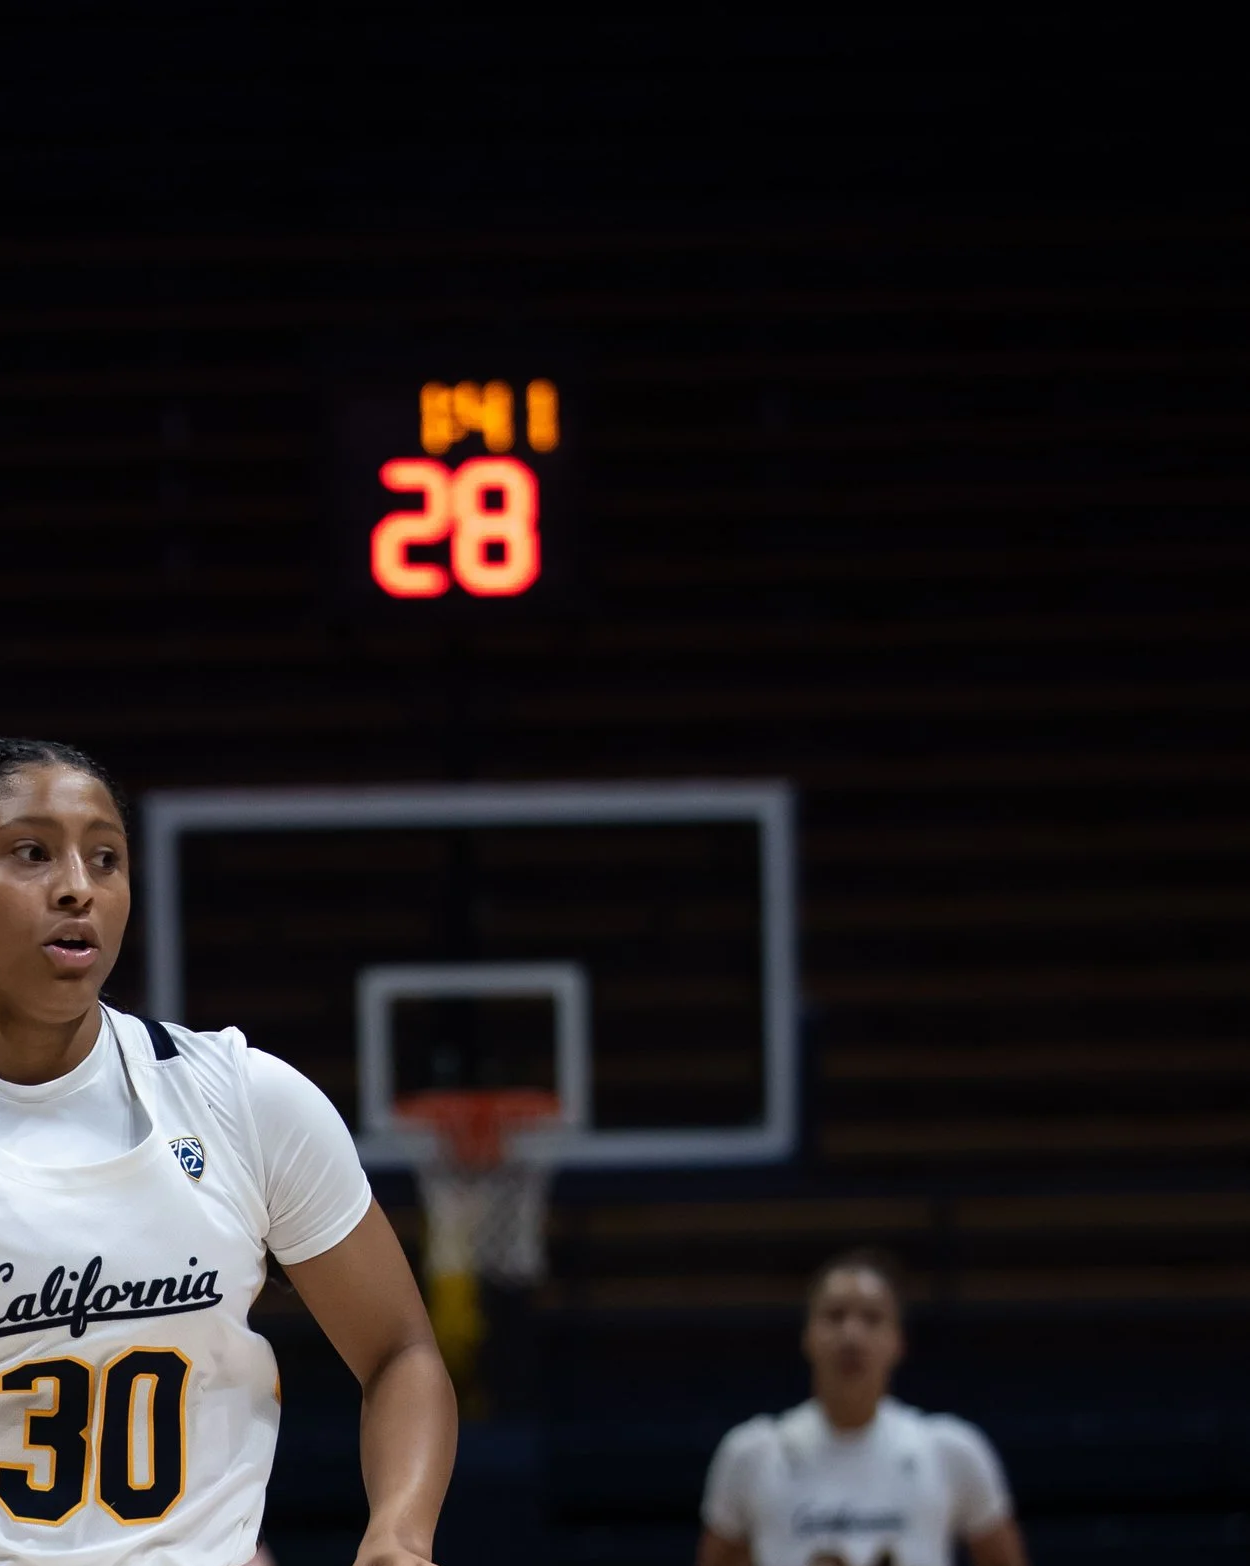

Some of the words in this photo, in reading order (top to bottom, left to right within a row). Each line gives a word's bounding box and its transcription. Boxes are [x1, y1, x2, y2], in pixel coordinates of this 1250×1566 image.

[370, 456, 542, 598] 28
[169, 1139, 204, 1162] PAC
[181, 1155, 203, 1173] 12
